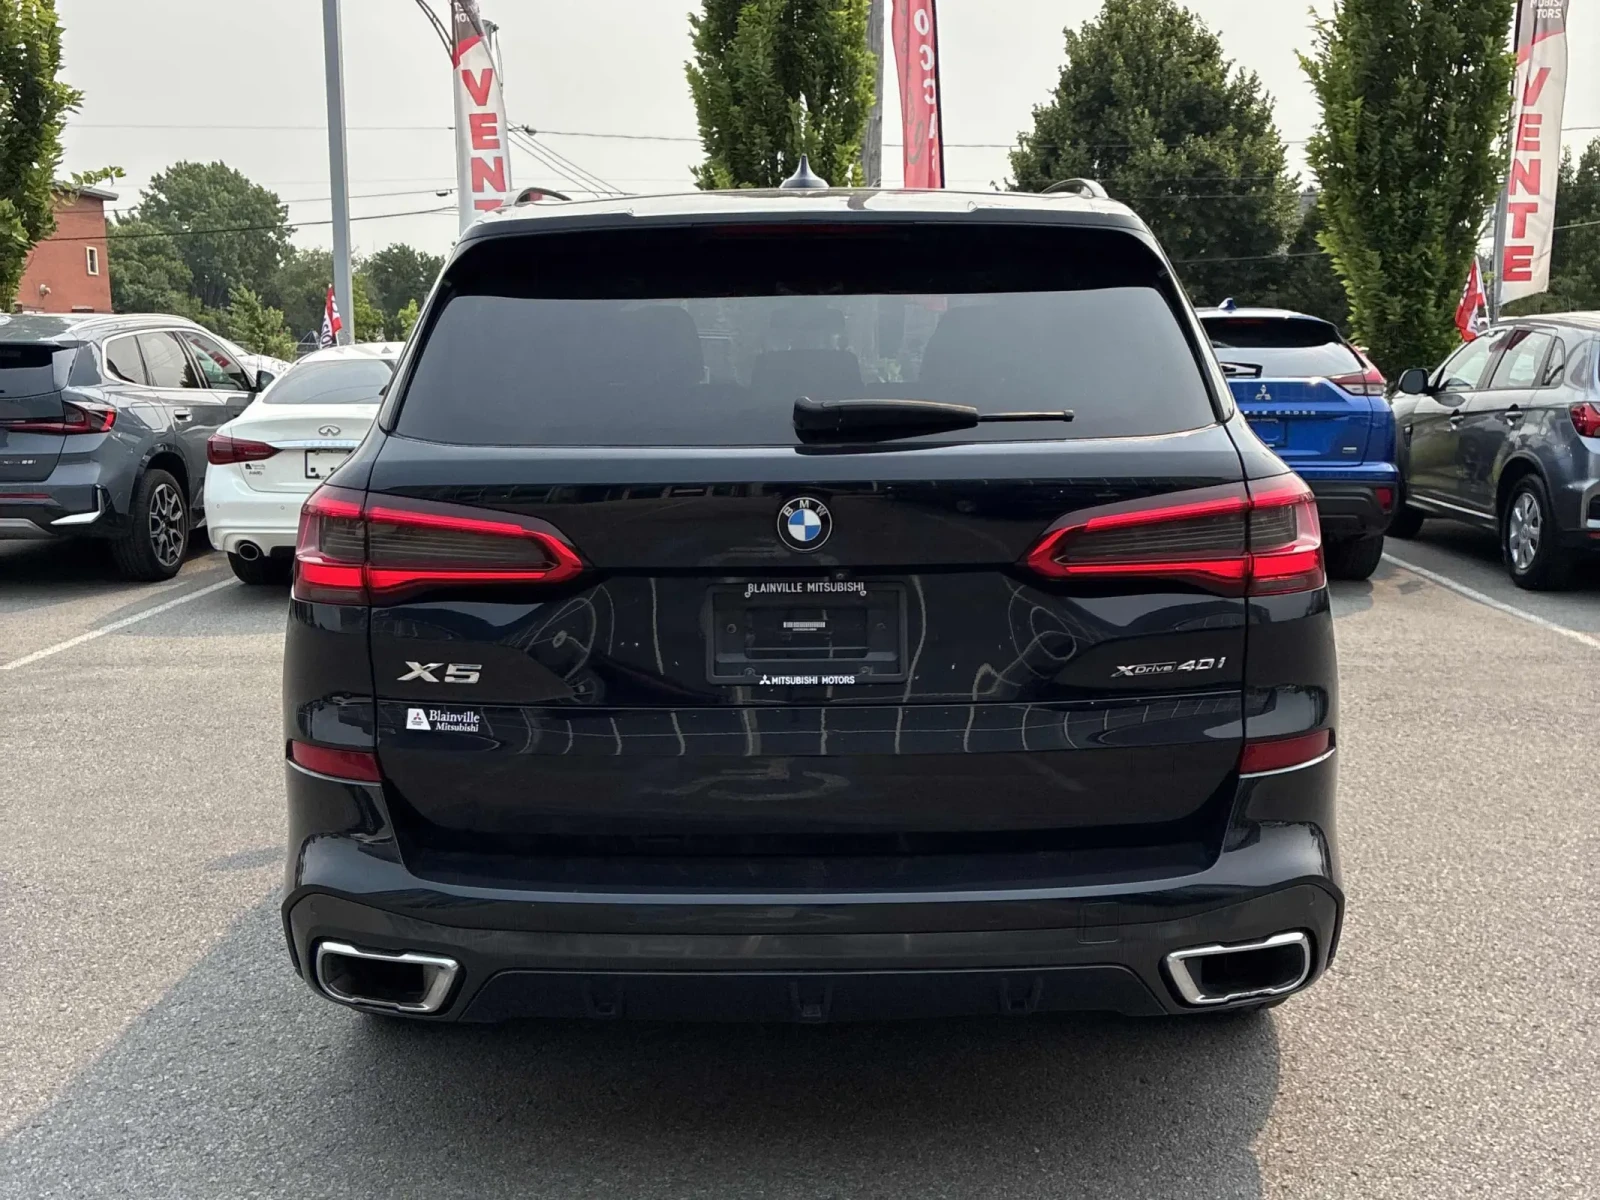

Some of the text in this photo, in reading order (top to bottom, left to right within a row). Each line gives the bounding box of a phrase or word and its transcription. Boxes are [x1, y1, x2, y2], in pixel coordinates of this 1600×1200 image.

[1536, 8, 1561, 18] TORS
[1502, 67, 1551, 282] VENTE
[783, 500, 827, 517] BMW
[747, 582, 865, 594] BLAINVILLE MITSUBISHI
[396, 660, 483, 684] X5
[771, 675, 855, 685] MITSUBISHI MOTORS
[429, 709, 480, 723] Blainville
[435, 721, 479, 732] Mitsubishi
